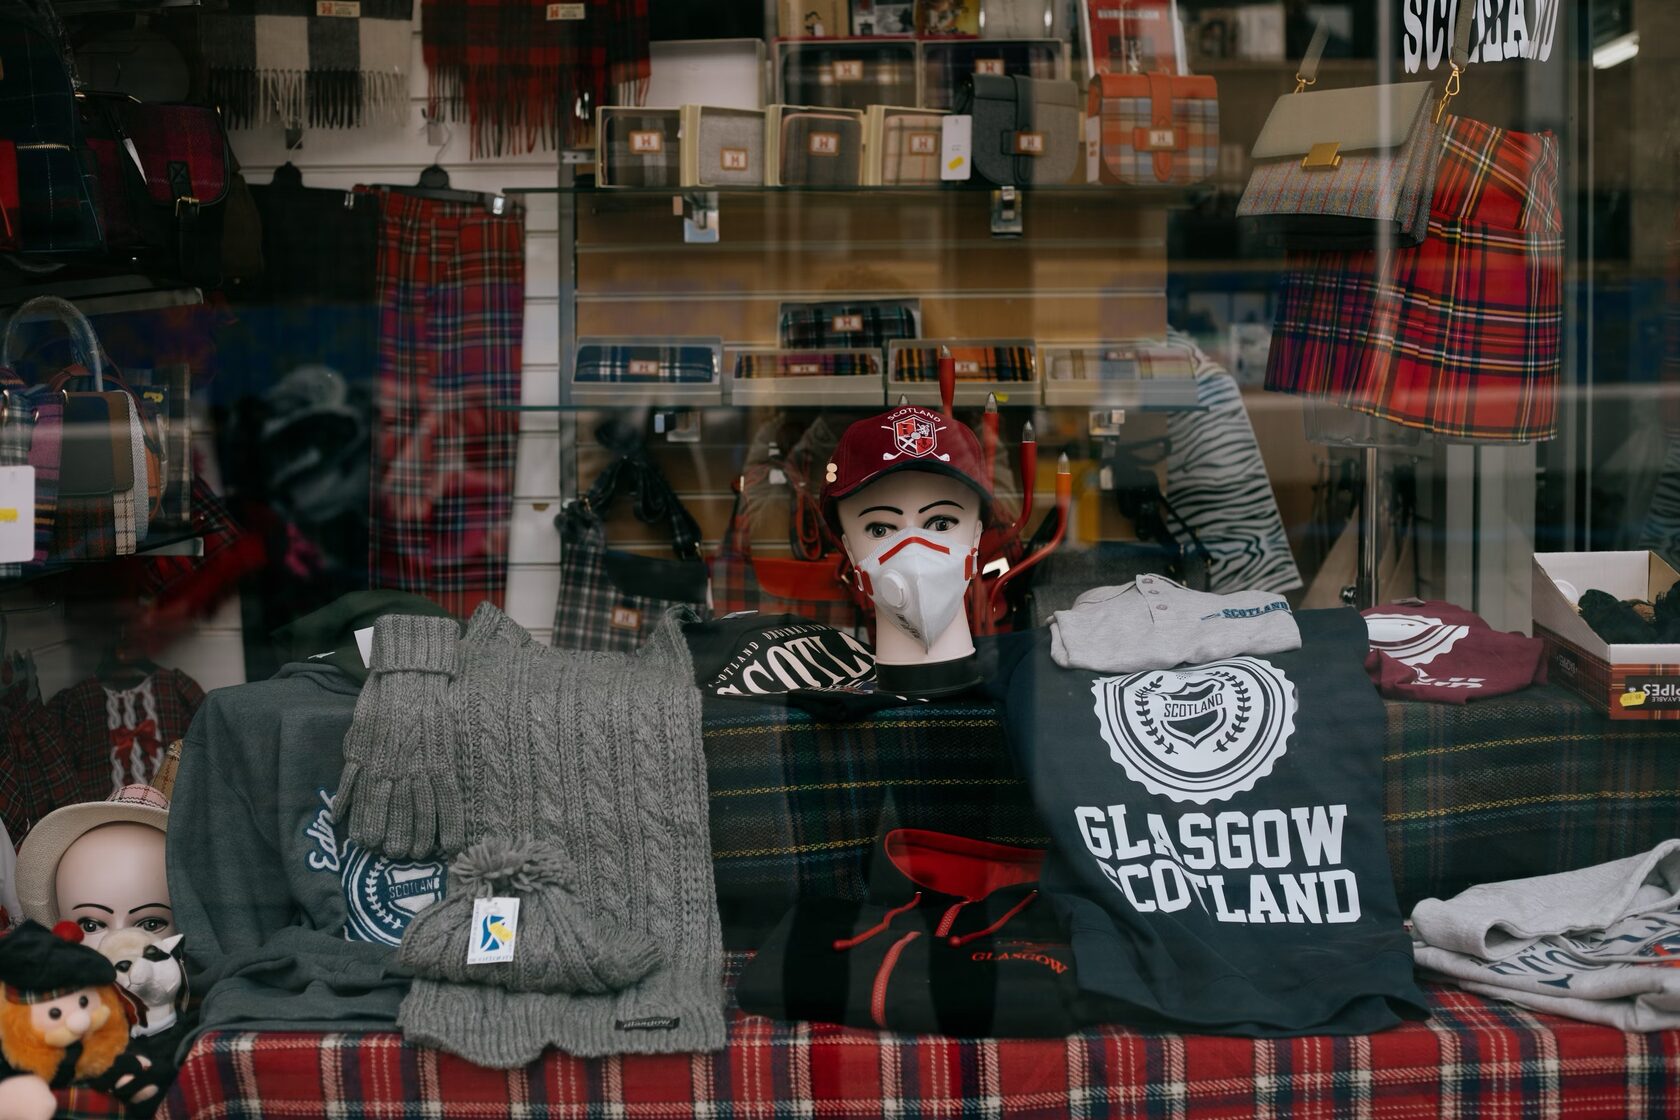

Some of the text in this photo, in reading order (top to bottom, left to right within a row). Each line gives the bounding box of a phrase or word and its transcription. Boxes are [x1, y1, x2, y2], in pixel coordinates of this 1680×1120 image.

[887, 407, 941, 422] SCOTLAND
[1222, 601, 1289, 618] SCOTLAND
[1164, 693, 1224, 718] SCOTLAND
[1074, 804, 1348, 869] GLASGOW
[388, 877, 440, 900] SCOTLAND
